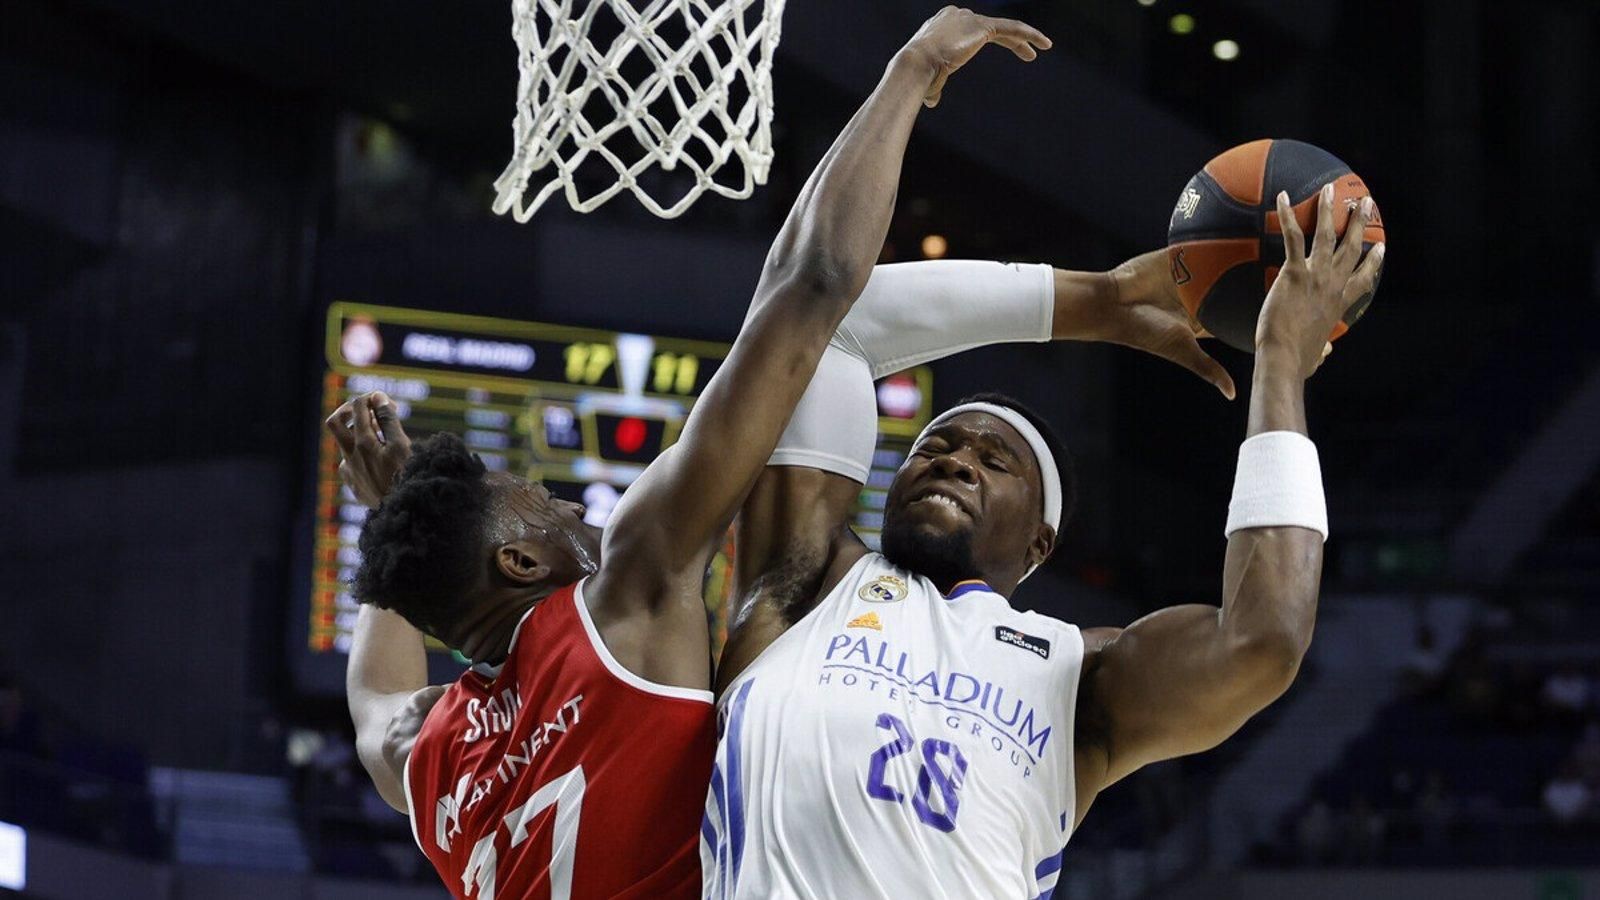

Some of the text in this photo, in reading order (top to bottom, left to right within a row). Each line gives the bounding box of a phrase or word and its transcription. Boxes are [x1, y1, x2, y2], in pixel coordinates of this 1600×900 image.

[563, 342, 616, 384] 17
[653, 351, 699, 395] 11
[818, 672, 1033, 779] HOTE GROUP
[825, 633, 1053, 760] PALLADIUM
[460, 763, 587, 900] 17
[865, 712, 969, 834] 28
